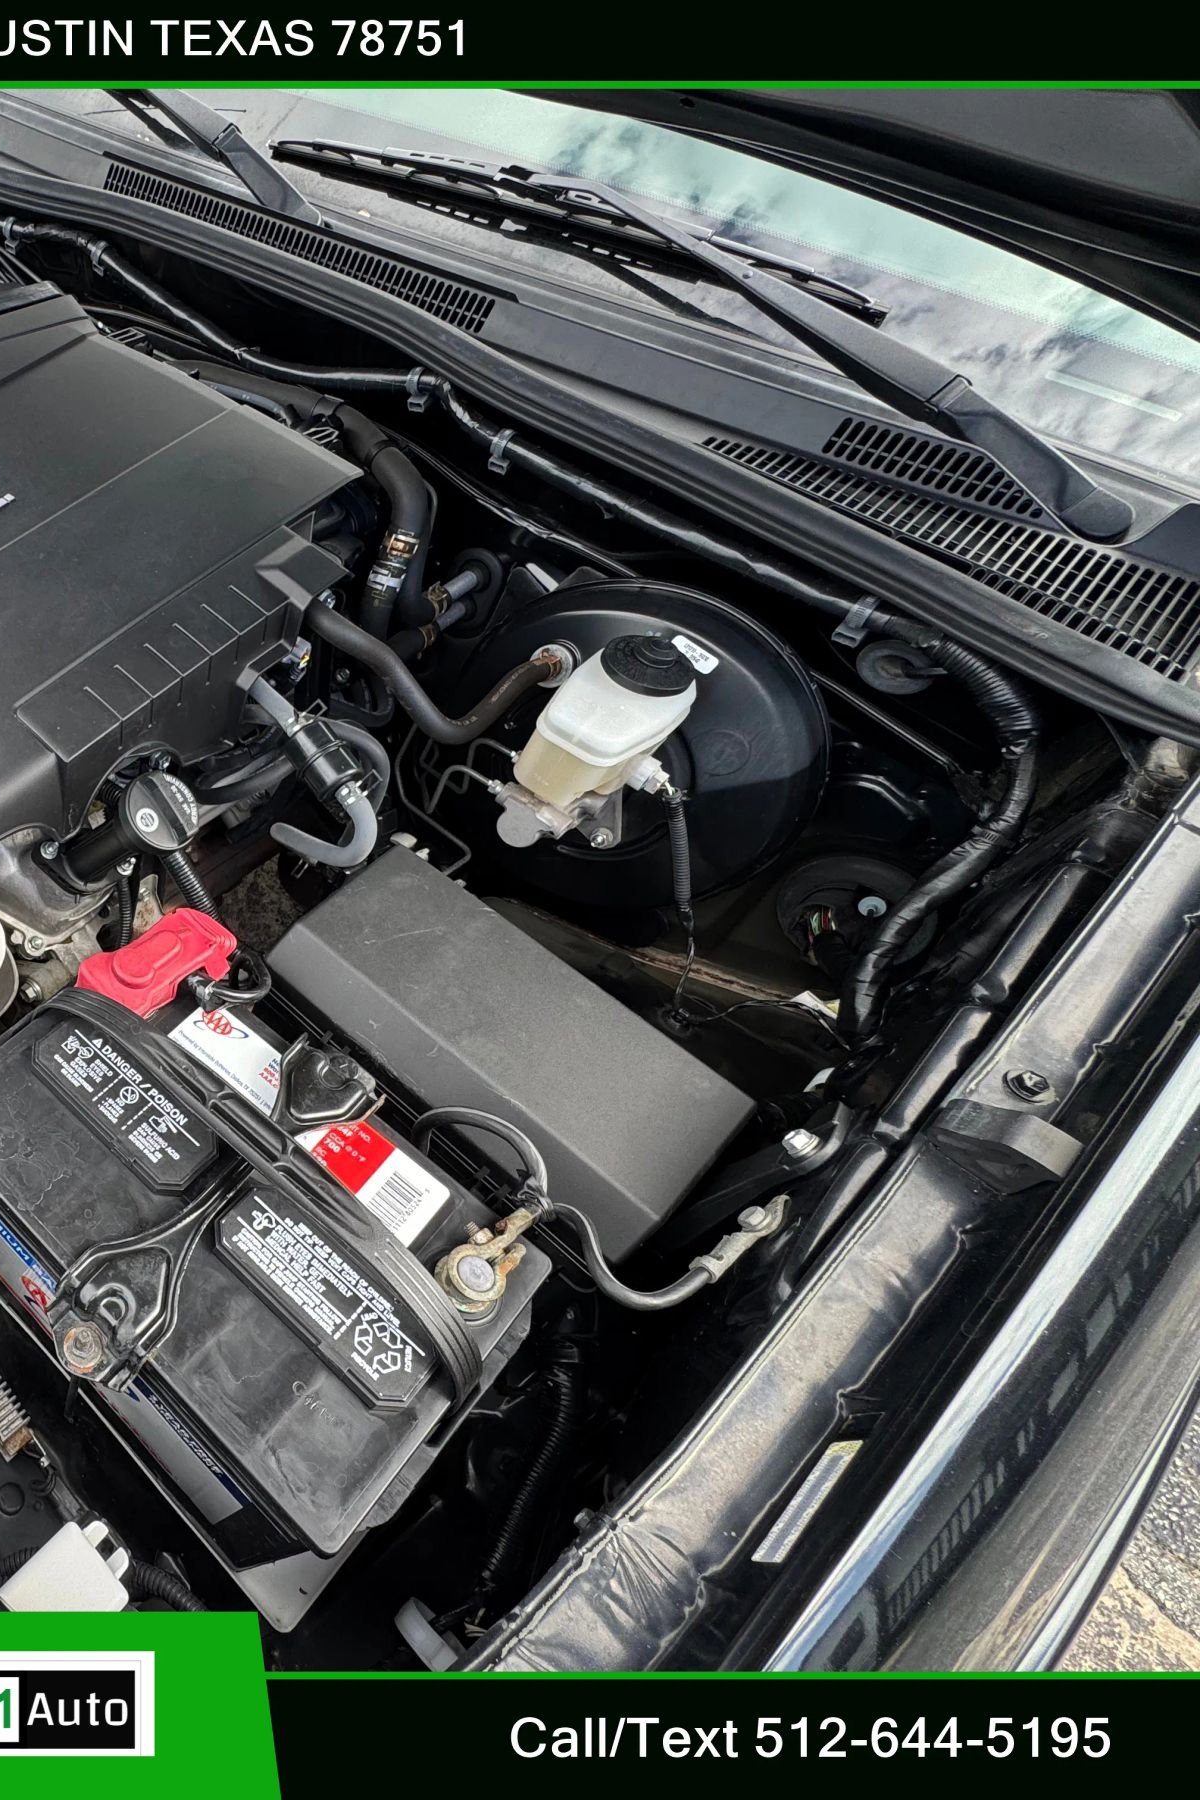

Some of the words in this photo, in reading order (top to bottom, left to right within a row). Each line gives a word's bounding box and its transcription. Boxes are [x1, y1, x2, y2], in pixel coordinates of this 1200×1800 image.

[70, 1061, 87, 1077] GASES
[73, 1057, 102, 1083] EXPLOSIVE
[90, 1063, 104, 1076] EYES
[94, 1059, 113, 1076] SHIELD
[98, 1045, 142, 1083] DANGER
[145, 1088, 188, 1125] POISON
[115, 1097, 125, 1106] NO
[140, 1122, 167, 1148] SULFURIC
[165, 1147, 179, 1159] ACID
[324, 1138, 340, 1152] 700
[326, 1133, 344, 1147] CCA
[265, 1235, 291, 1262] MEDICAL
[290, 1260, 309, 1276] HELP
[307, 1276, 326, 1292] FAST
[270, 1230, 287, 1247] WITH
[309, 1267, 324, 1280] GET
[274, 1225, 296, 1245] FLUSH
[294, 1243, 312, 1260] EYES
[310, 1258, 353, 1297] IMMEDIATELY
